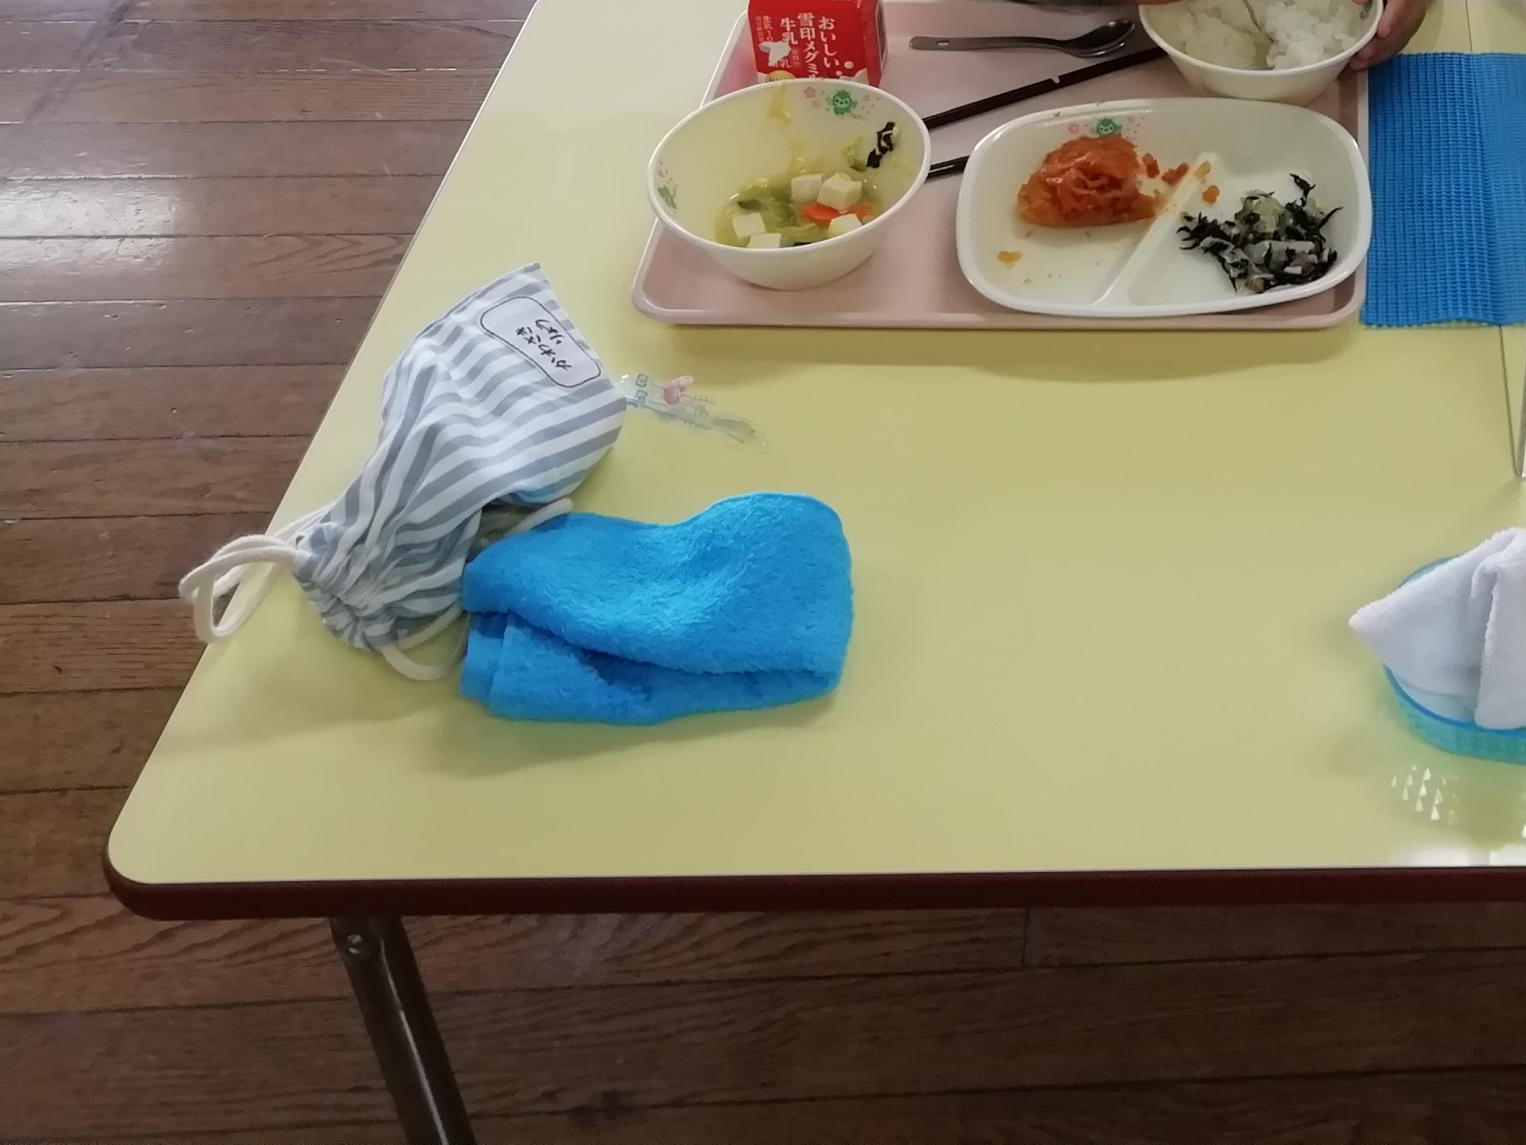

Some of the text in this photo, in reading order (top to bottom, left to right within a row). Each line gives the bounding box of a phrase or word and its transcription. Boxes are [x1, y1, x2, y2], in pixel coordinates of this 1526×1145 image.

[780, 17, 798, 45] 牛乳
[818, 16, 840, 69] おいしい
[515, 326, 573, 371] かわさき
